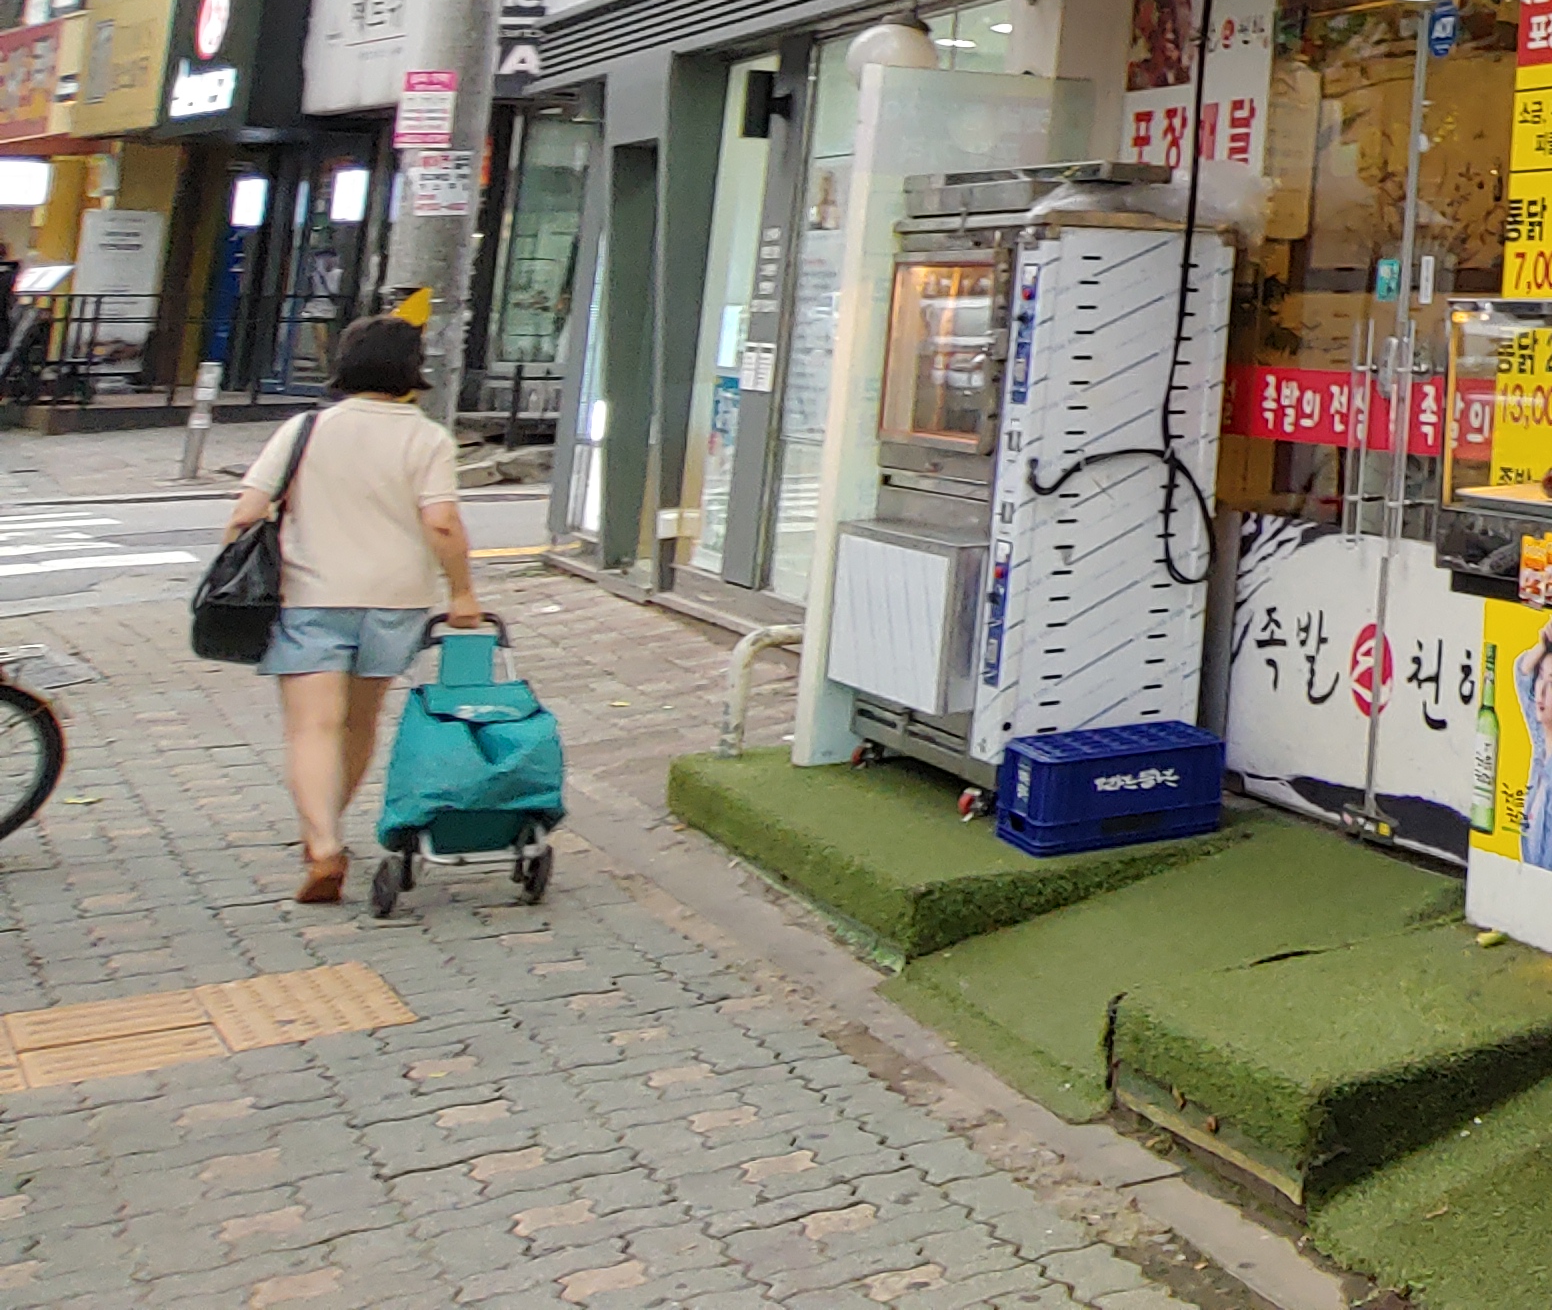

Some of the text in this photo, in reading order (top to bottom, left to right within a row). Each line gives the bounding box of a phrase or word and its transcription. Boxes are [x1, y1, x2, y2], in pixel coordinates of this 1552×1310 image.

[1131, 106, 1188, 170] 포장
[1506, 196, 1547, 242] 통닭
[1264, 374, 1322, 434] 족발의
[1254, 606, 1340, 705] 족발
